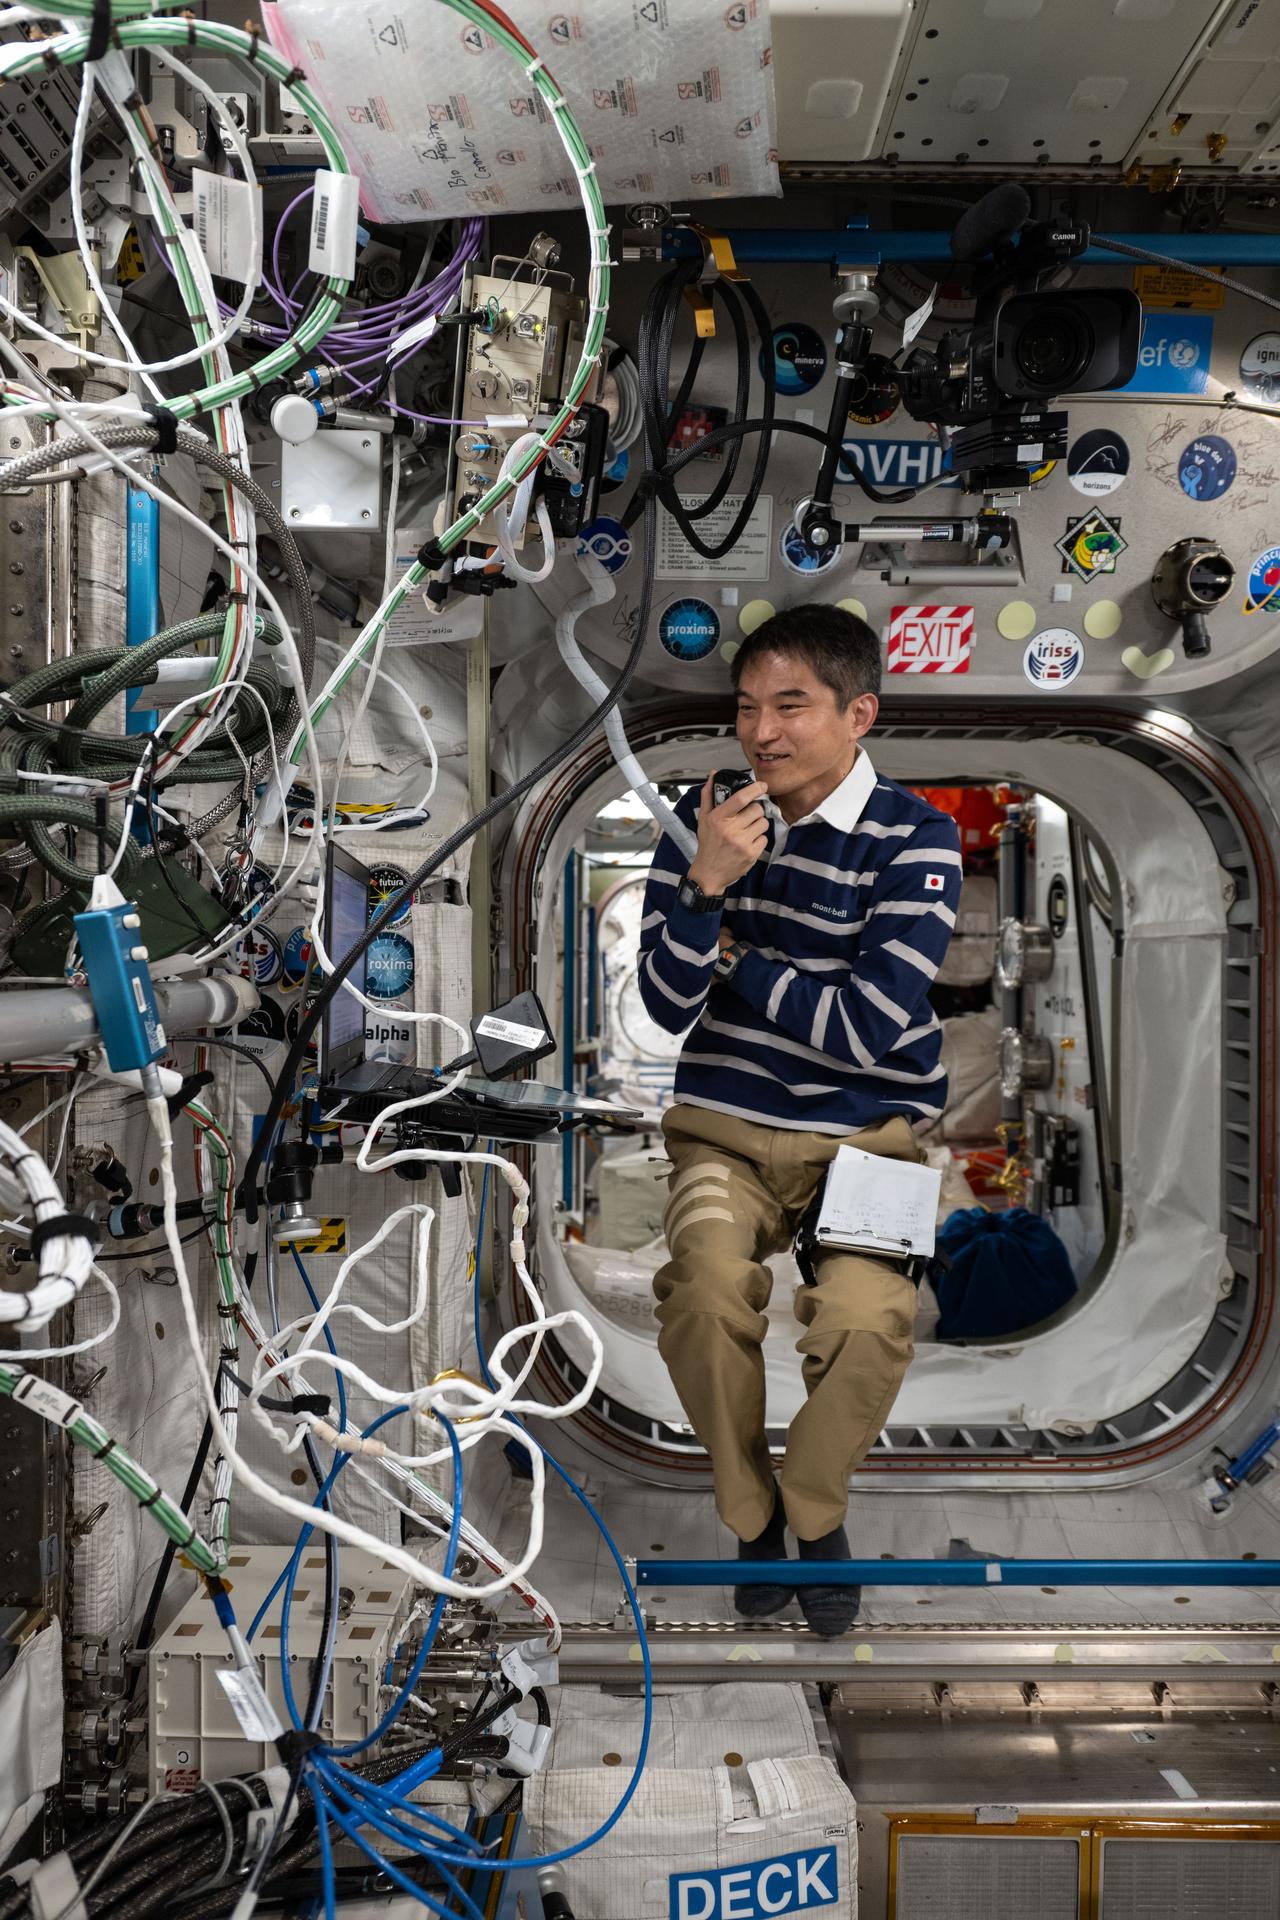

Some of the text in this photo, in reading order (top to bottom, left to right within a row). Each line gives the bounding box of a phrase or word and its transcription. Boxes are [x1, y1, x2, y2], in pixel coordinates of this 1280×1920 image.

[794, 357, 824, 365] minerva
[1194, 442, 1223, 464] blue dot
[1083, 482, 1112, 491] horizons
[666, 623, 715, 636] proxima
[902, 623, 960, 657] EXIT
[1037, 643, 1072, 658] iriss
[379, 878, 404, 887] futura
[235, 940, 268, 956] riss
[369, 959, 413, 970] roxima
[366, 1025, 410, 1043] alpha
[678, 1853, 834, 1920] DECK
